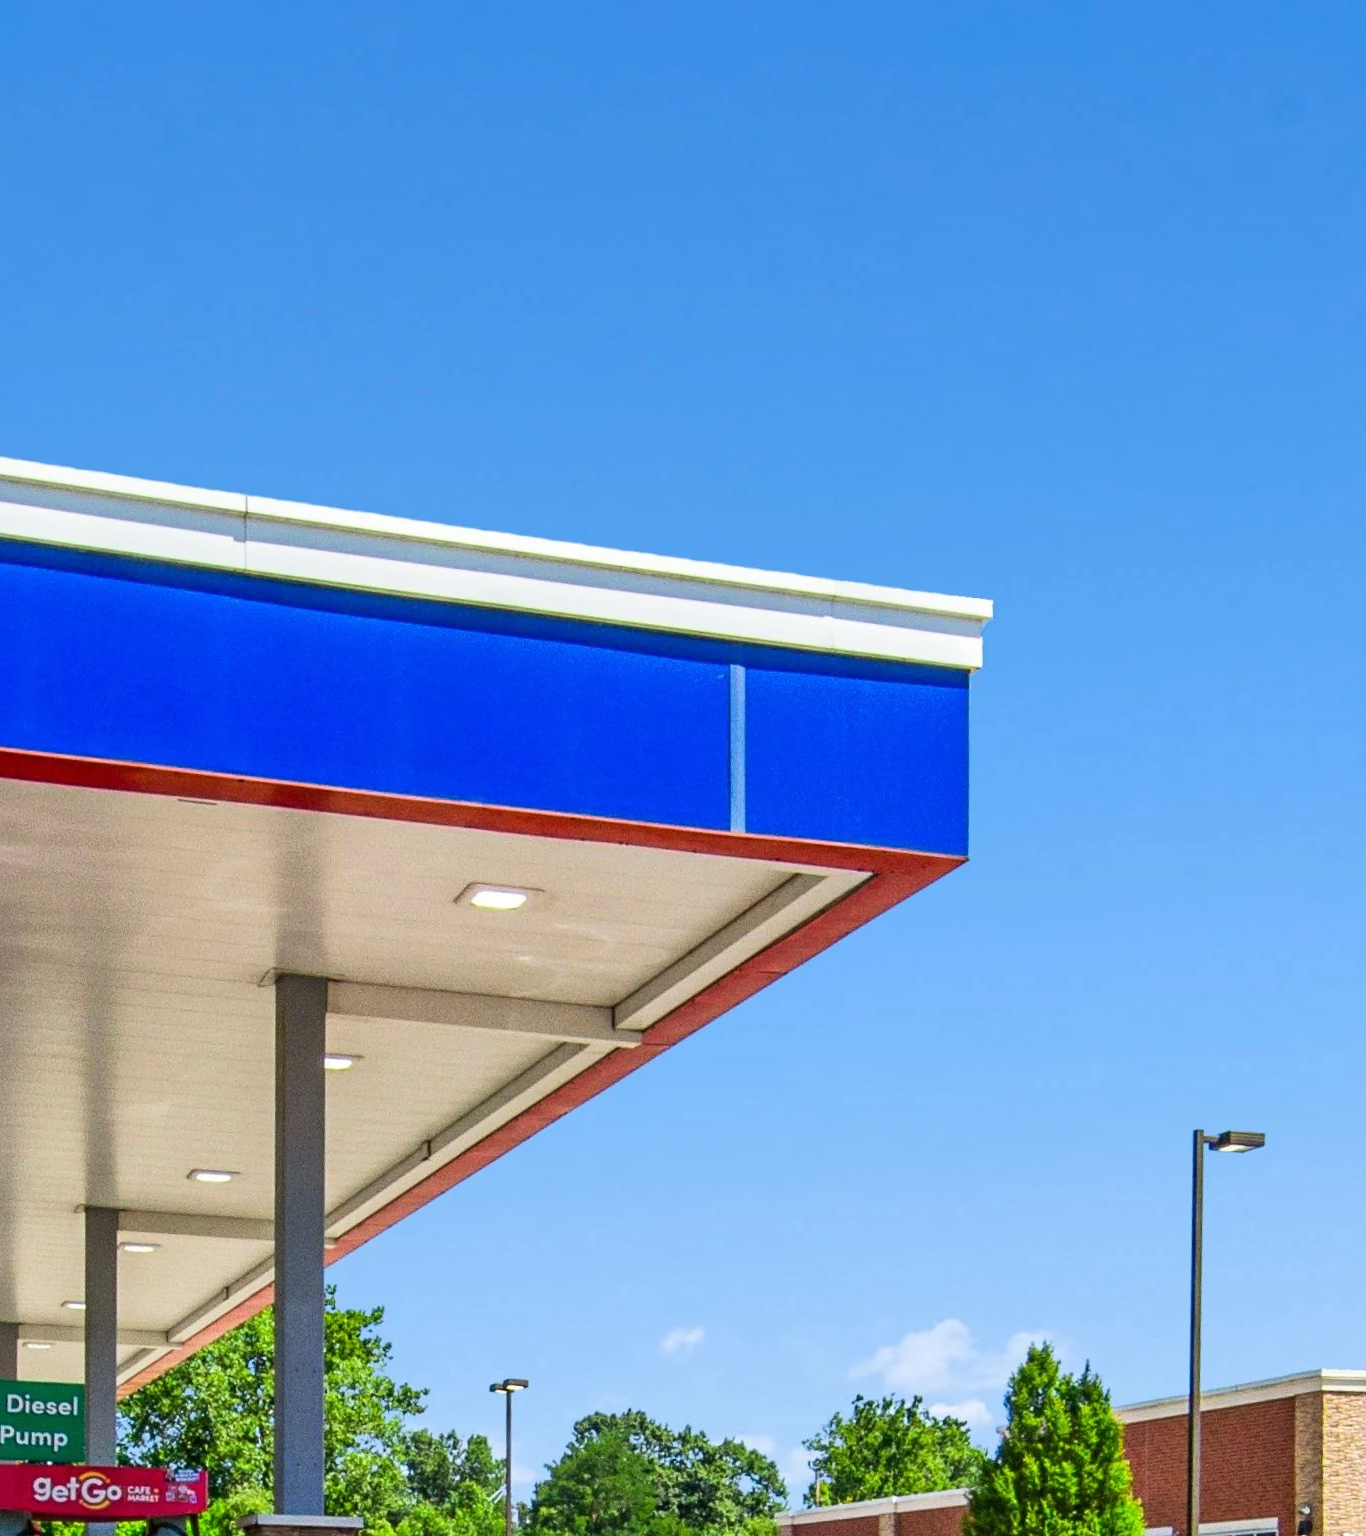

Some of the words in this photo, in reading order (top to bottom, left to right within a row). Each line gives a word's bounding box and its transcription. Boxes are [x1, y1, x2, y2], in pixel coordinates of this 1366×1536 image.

[6, 1393, 79, 1416] Diesel
[0, 1424, 69, 1453] Pump
[32, 1476, 123, 1503] getGo
[126, 1485, 152, 1496] CAFE
[126, 1494, 160, 1503] MARKET
